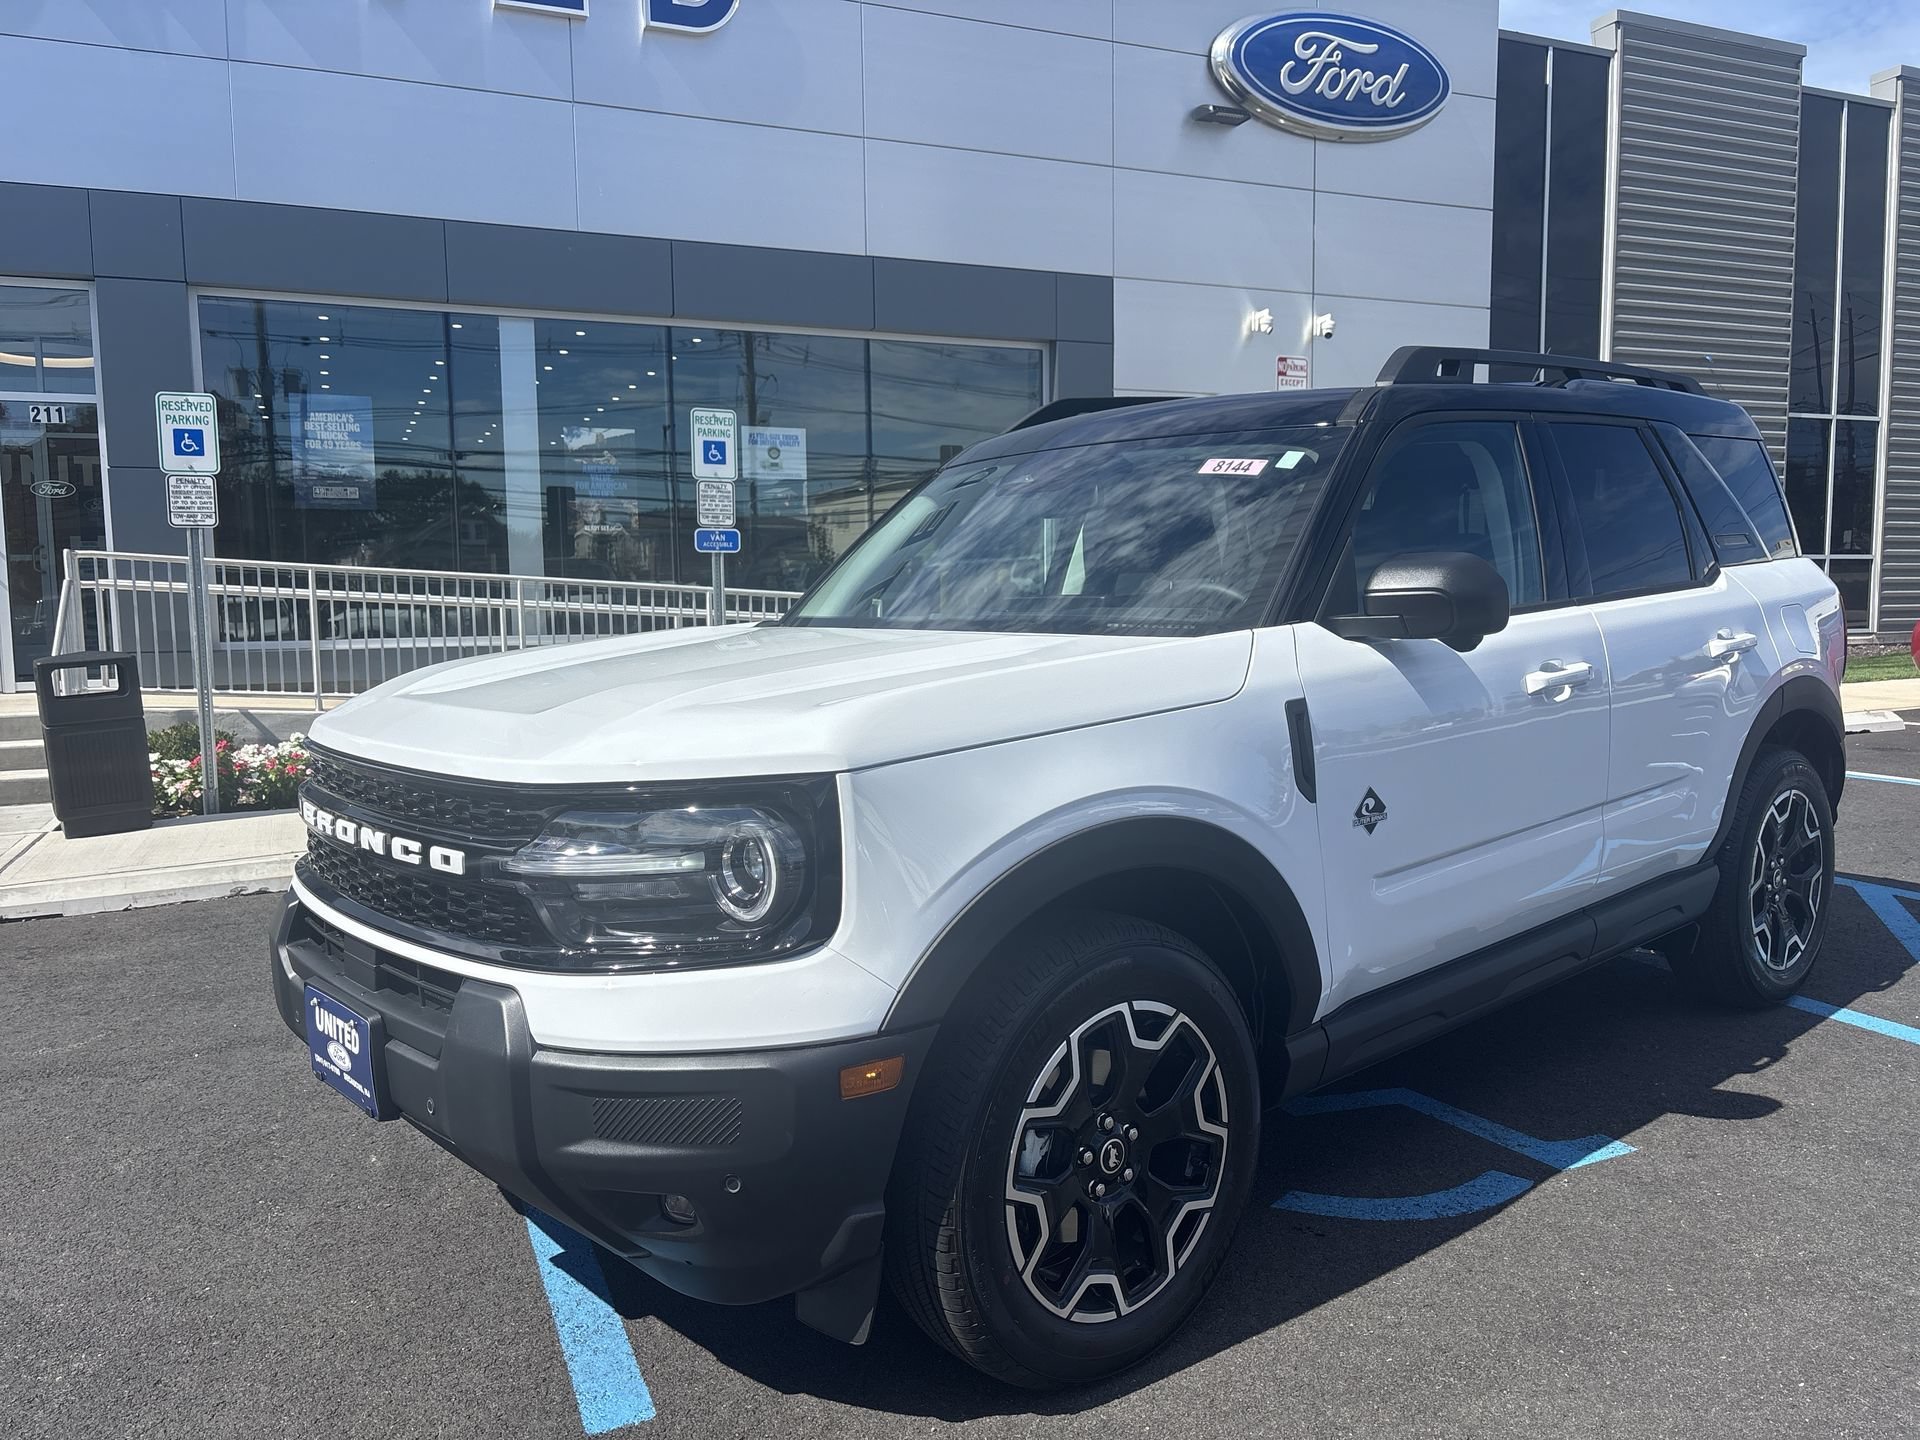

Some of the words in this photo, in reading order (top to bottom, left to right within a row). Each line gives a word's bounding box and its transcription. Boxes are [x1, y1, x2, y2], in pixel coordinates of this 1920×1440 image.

[1280, 31, 1410, 108] Ford
[1280, 378, 1304, 387] EXCEPT
[161, 400, 212, 412] RESERVED
[31, 406, 64, 423] 211
[165, 414, 210, 426] PARKING
[309, 412, 354, 423] AMERICA'S
[304, 421, 361, 432] BEST-SELLING
[695, 415, 733, 427] RESERVED
[316, 431, 349, 440] TRUCKS
[698, 428, 731, 438] PARKING
[304, 439, 321, 449] FOR
[322, 440, 333, 449] 49
[334, 440, 362, 450] YEARS
[1212, 460, 1254, 473] 8144
[175, 477, 207, 485] PENALTY
[39, 483, 67, 496] Ford
[710, 533, 726, 541] VAN
[302, 801, 466, 875] BRONCO
[315, 1005, 360, 1055] UNITED
